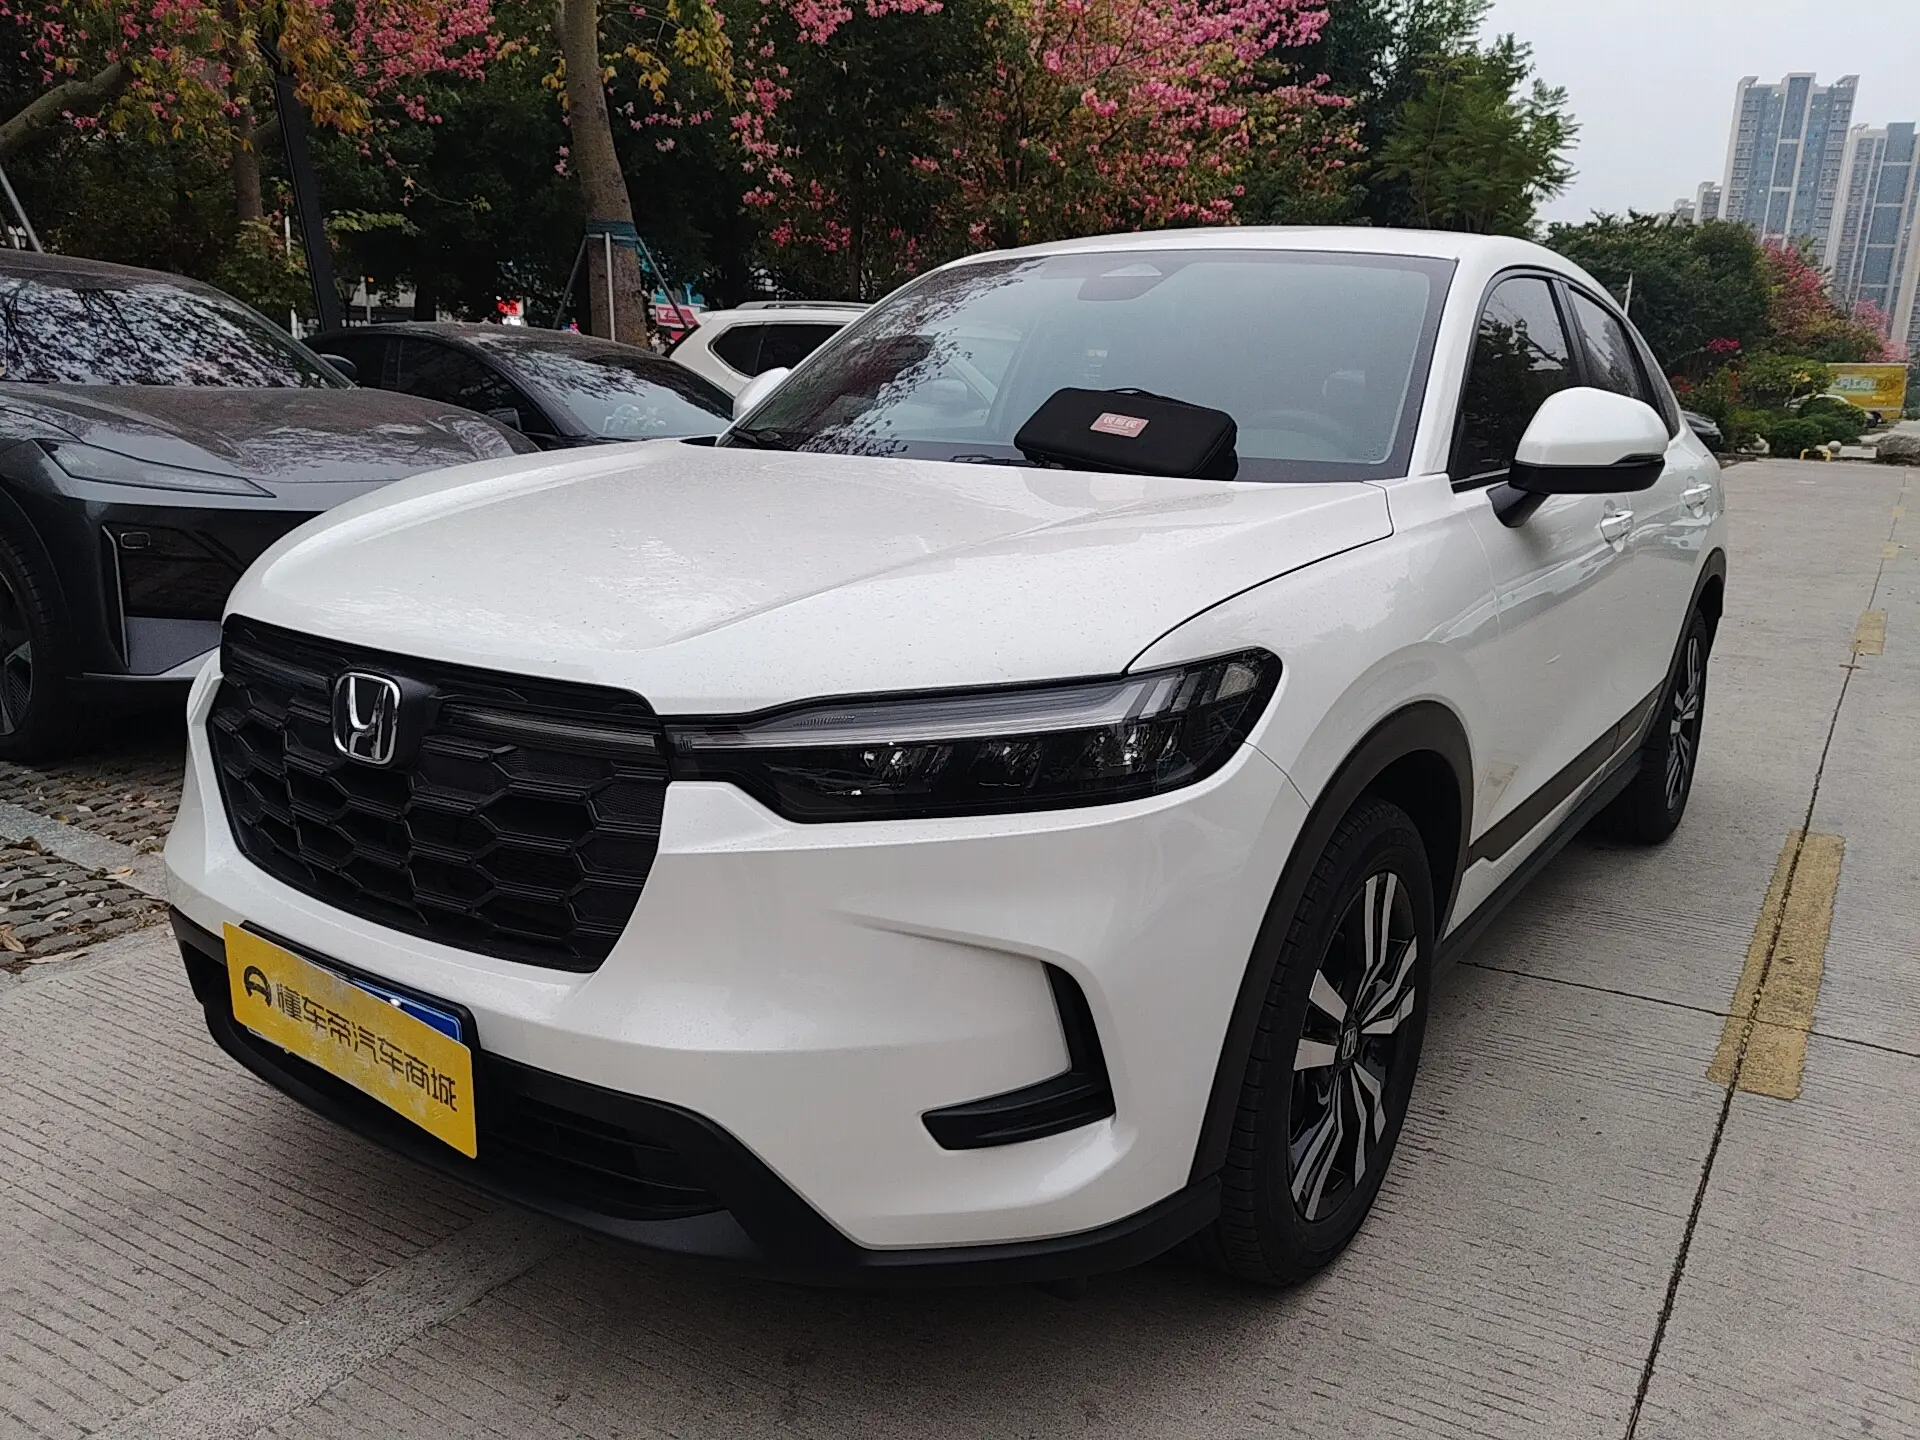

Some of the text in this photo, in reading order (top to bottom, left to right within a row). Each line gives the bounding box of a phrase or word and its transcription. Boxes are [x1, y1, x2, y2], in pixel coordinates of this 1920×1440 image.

[276, 982, 458, 1113] 懂车帝汽车商城
